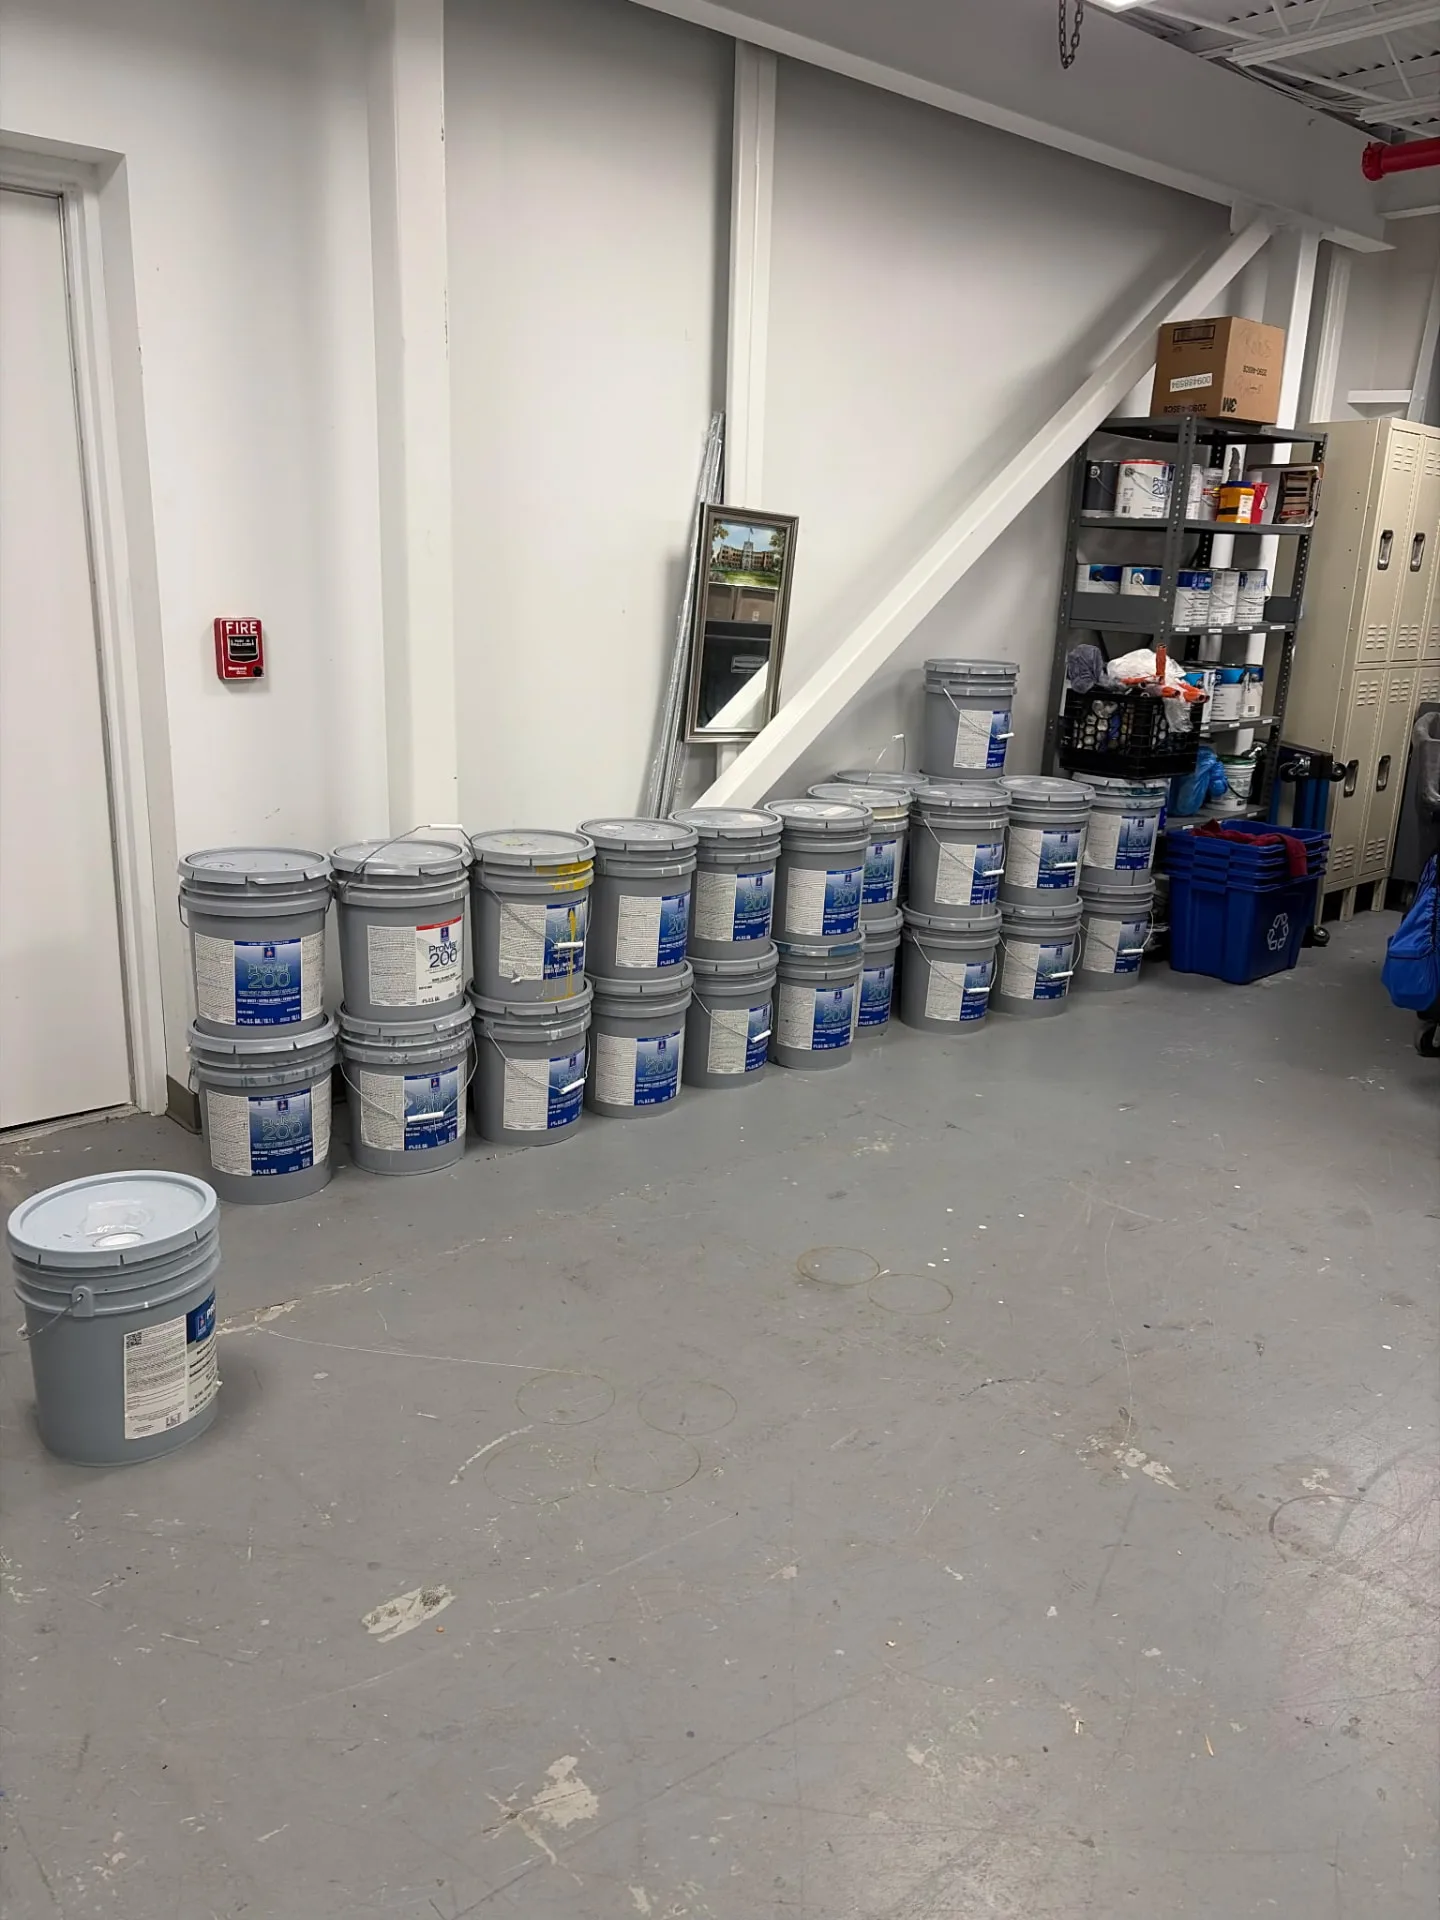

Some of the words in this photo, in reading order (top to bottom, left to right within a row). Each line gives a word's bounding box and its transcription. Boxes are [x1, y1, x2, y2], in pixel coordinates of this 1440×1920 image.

[1222, 397, 1237, 413] 3M
[225, 621, 258, 634] FIRE
[430, 948, 458, 968] 200
[248, 972, 291, 989] 200
[263, 1121, 303, 1141] 200
